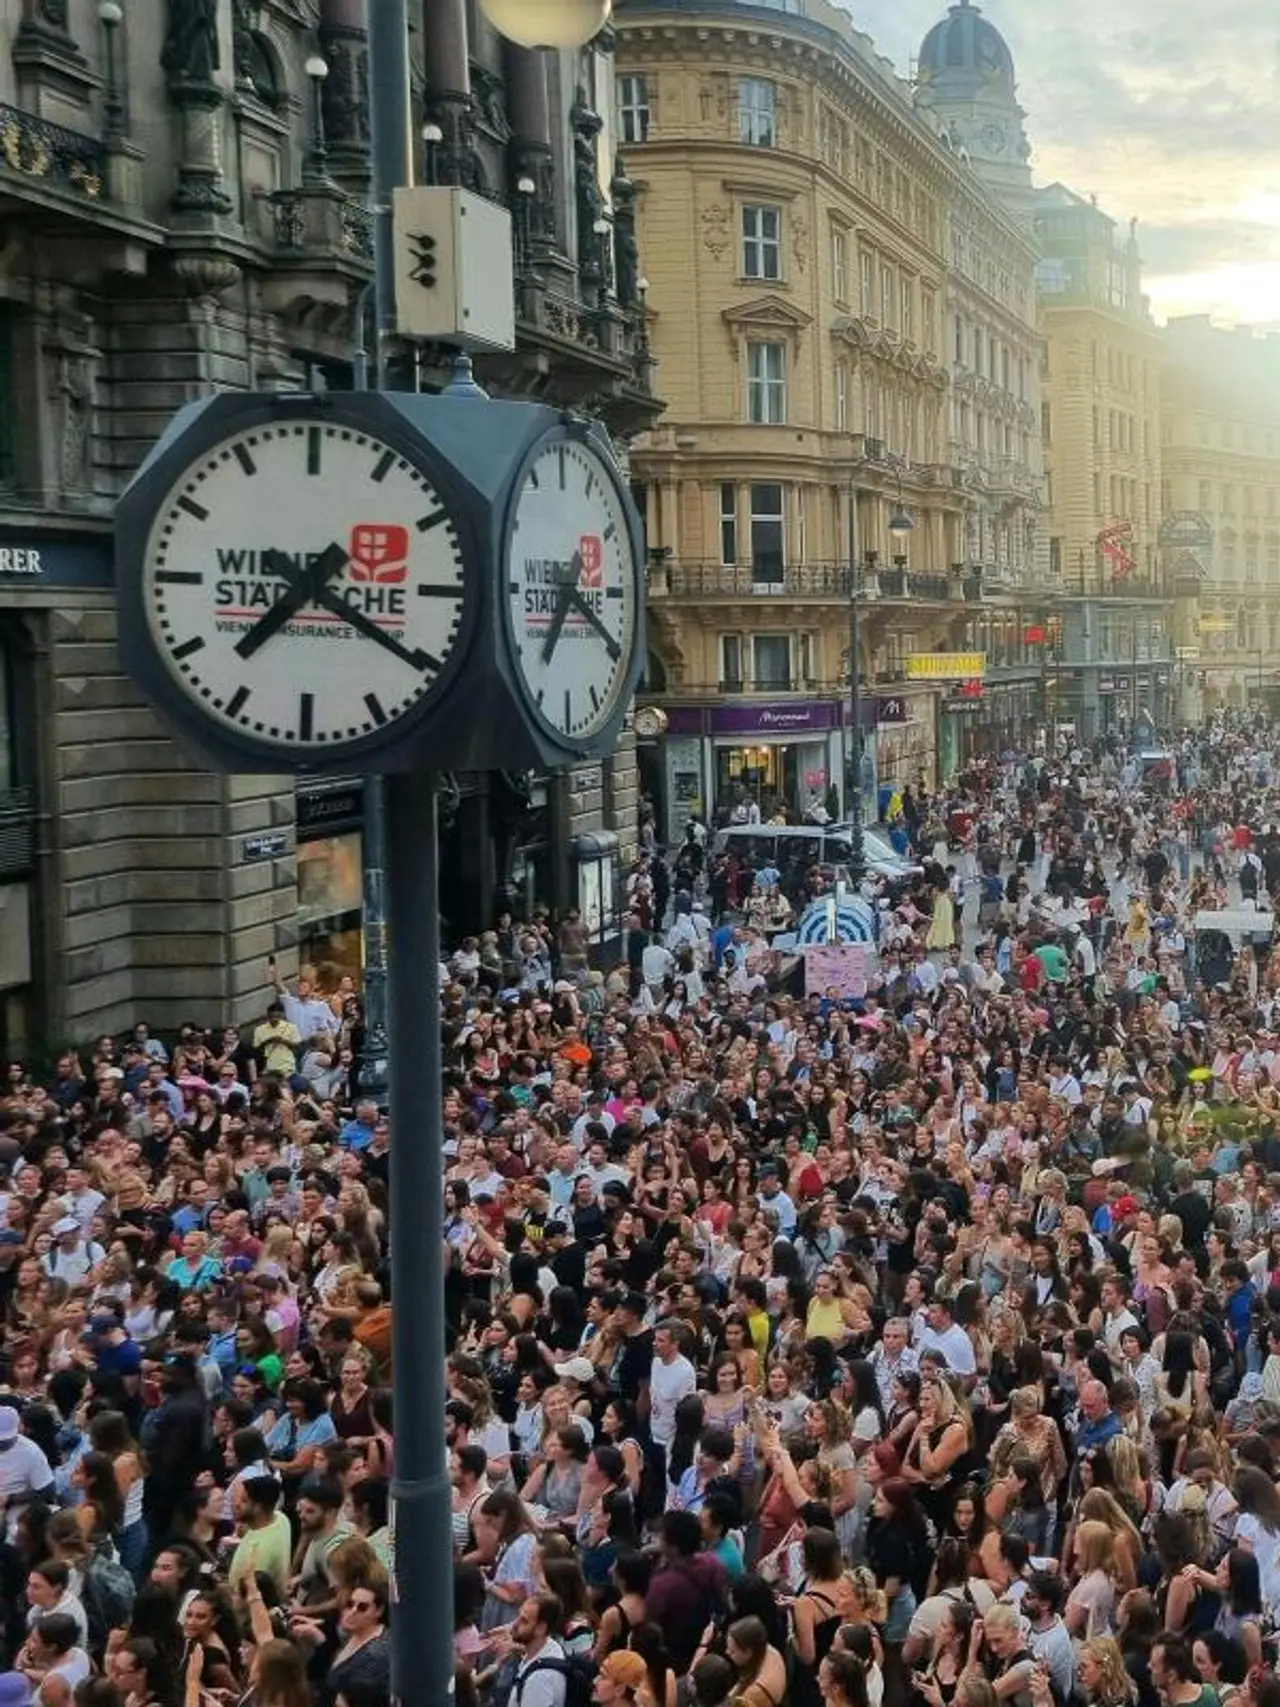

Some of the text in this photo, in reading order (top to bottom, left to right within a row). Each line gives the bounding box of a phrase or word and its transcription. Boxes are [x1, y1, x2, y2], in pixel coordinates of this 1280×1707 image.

[0, 547, 44, 573] RER
[216, 549, 344, 580] WIE
[215, 580, 406, 615] STÄDCHE
[525, 588, 603, 615] STÄDHE
[215, 620, 270, 637] VIEN
[279, 625, 352, 640] NSURANCE
